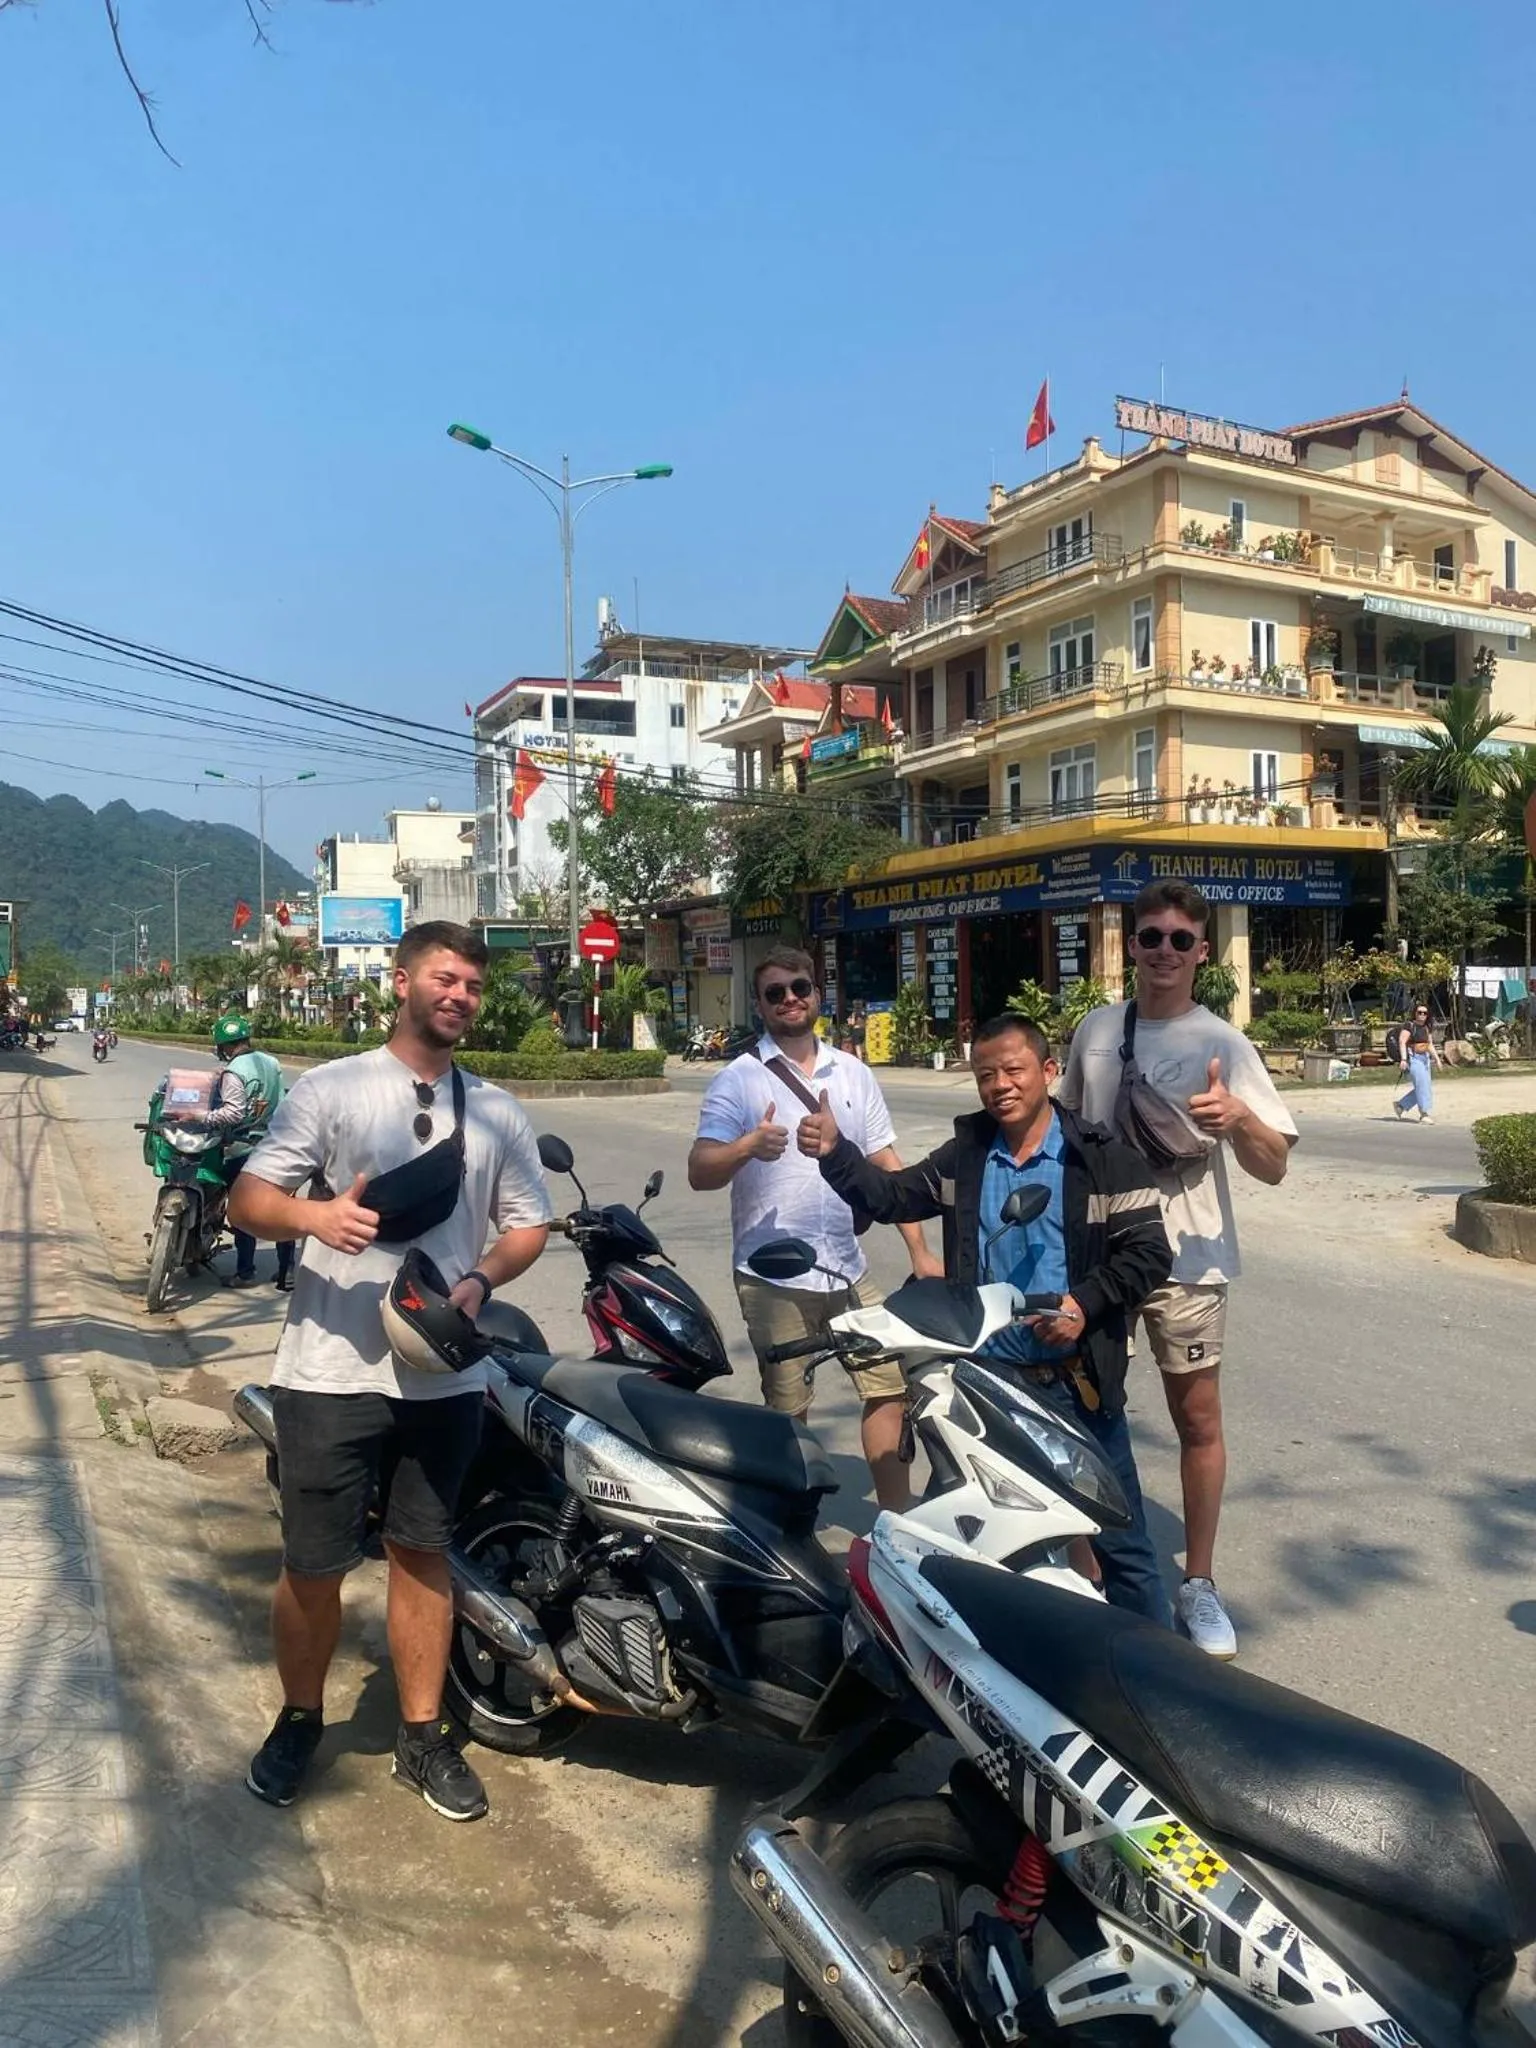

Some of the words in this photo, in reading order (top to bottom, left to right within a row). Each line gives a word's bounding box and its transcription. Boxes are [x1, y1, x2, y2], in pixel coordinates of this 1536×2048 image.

[1240, 429, 1296, 465] HOTEL
[1149, 854, 1205, 878] THANH
[1209, 855, 1248, 879] PHAT
[1255, 857, 1304, 881] HOTEL
[852, 881, 914, 910] THANH
[917, 874, 970, 900] PHAT
[972, 863, 1045, 891] HOTEL
[1237, 885, 1285, 902] OFFICE
[888, 903, 946, 923] BOOKING
[948, 896, 1001, 915] OFFICE
[746, 919, 780, 933] HOSTEL
[586, 1478, 632, 1502] YAMAHA
[958, 1660, 993, 1694] Limited
[991, 1690, 1023, 1725] Edition
